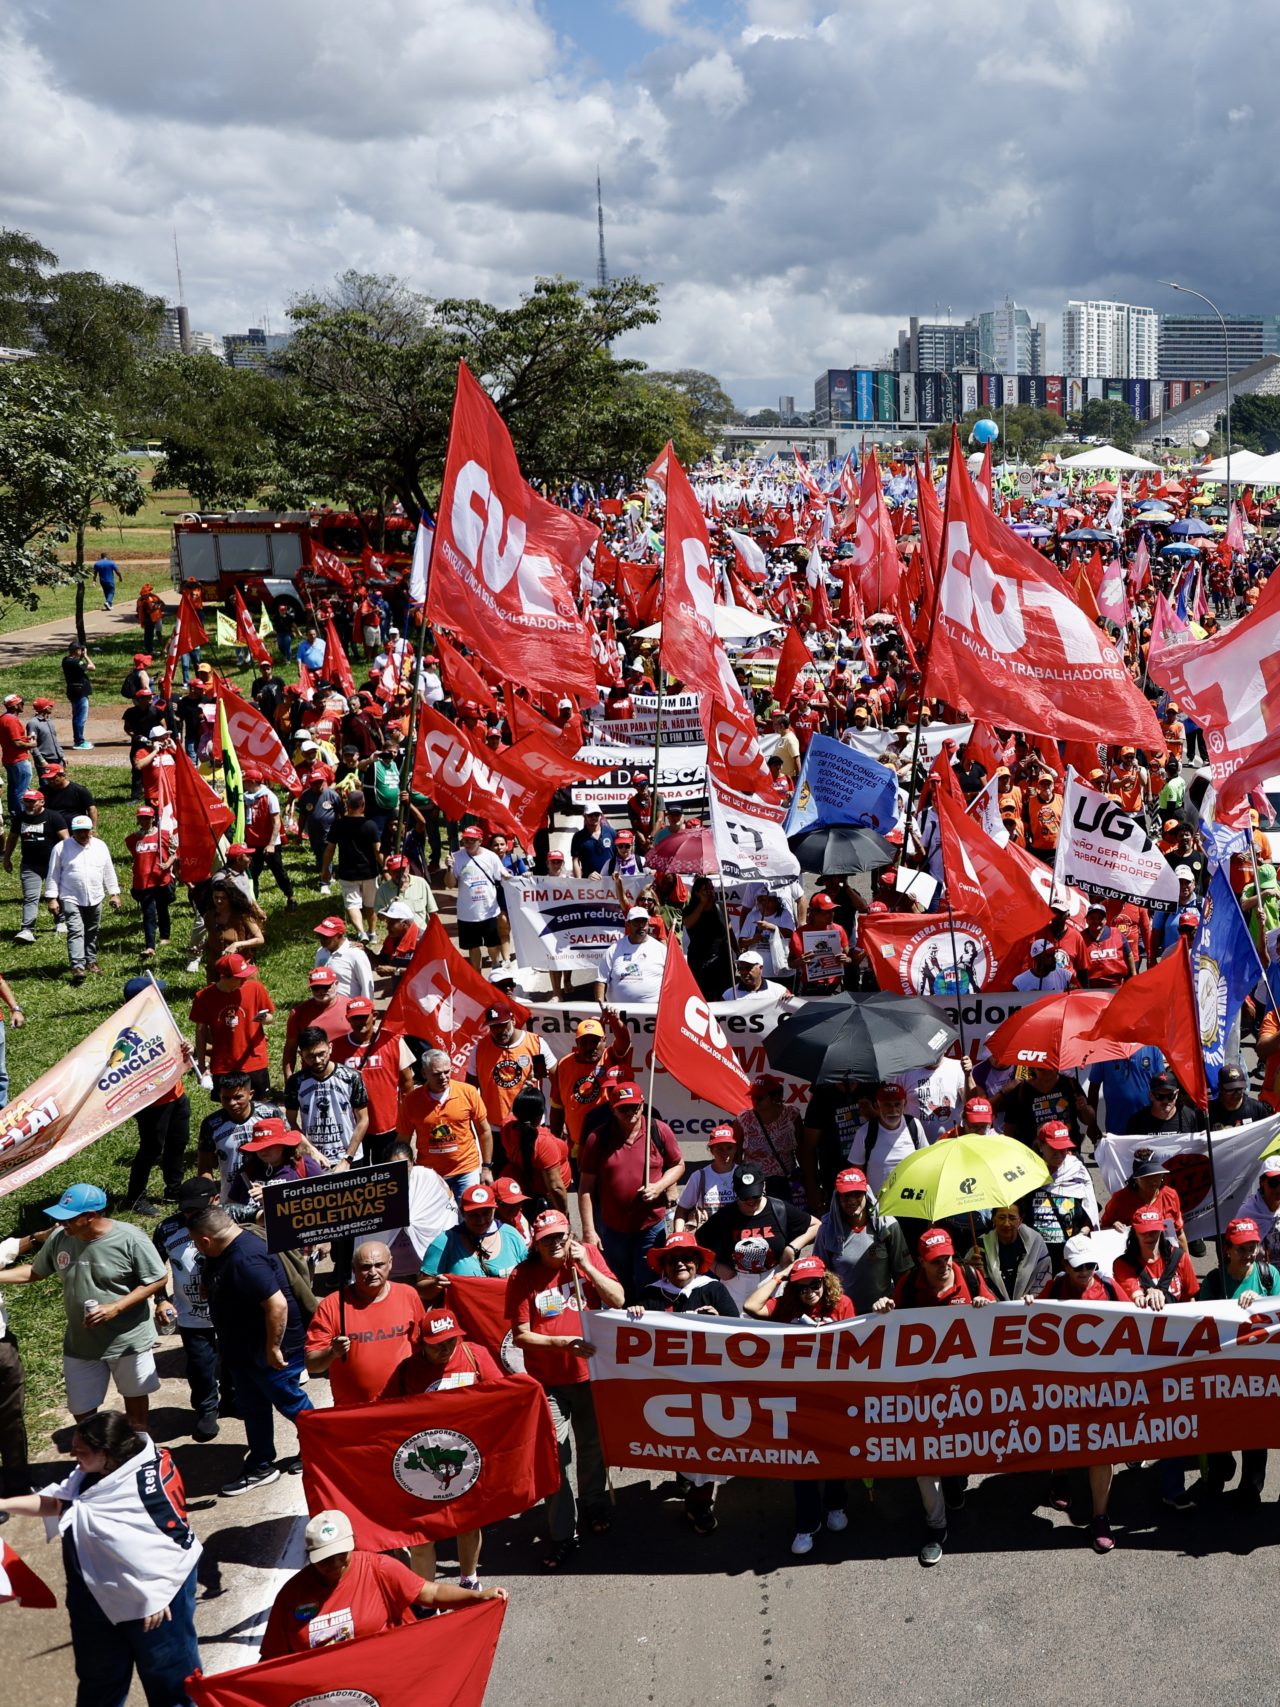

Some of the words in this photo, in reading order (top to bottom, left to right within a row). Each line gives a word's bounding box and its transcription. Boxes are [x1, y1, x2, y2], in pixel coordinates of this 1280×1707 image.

[451, 459, 556, 617] CUT
[940, 521, 1103, 664] CUT
[680, 696, 692, 707] DA
[630, 721, 648, 732] PARA
[837, 756, 851, 767] DOS
[826, 778, 855, 795] CARGAS
[827, 762, 877, 789] TRANSPORTES
[514, 789, 538, 822] RASIL
[1097, 847, 1132, 863] GERAL
[1137, 857, 1162, 870] DOS
[523, 890, 549, 902] FIM
[553, 889, 573, 901] DA
[1105, 888, 1126, 900] UGT
[1127, 893, 1149, 907] UGT
[1150, 900, 1170, 911] UGT
[557, 911, 581, 923] sem
[911, 925, 936, 944] TERRA
[938, 920, 982, 936] TRABALHO
[1090, 948, 1117, 959] CUT
[138, 1034, 162, 1053] 2026
[97, 1041, 167, 1092] CONCLAT
[1017, 1049, 1047, 1063] CUT
[282, 1174, 368, 1199] Fortalecimento
[370, 1170, 391, 1182] das
[276, 1180, 399, 1217] NEGOCIAÇÕES
[292, 1200, 386, 1229] COLETIVAS
[303, 1232, 343, 1244] SOROCABA
[351, 1224, 378, 1236] REGIÃO
[616, 1326, 770, 1369] PELO
[781, 1325, 886, 1370] FIM
[895, 1318, 977, 1367] DA
[989, 1313, 1222, 1357] ESCALA
[864, 1384, 983, 1428] REDUÇÃO
[991, 1386, 1026, 1414] DA
[1032, 1378, 1150, 1410] JORNADA
[1162, 1377, 1194, 1403] DE
[643, 1393, 797, 1440] CUT
[403, 1430, 456, 1449] TRABALHADORES
[865, 1436, 916, 1463] SEM
[923, 1420, 1041, 1463] REDUÇÃO
[1049, 1423, 1080, 1452] DE
[1087, 1412, 1198, 1451] SALÁRIO!
[629, 1441, 702, 1461] SANTA
[706, 1446, 820, 1465] CATARINA
